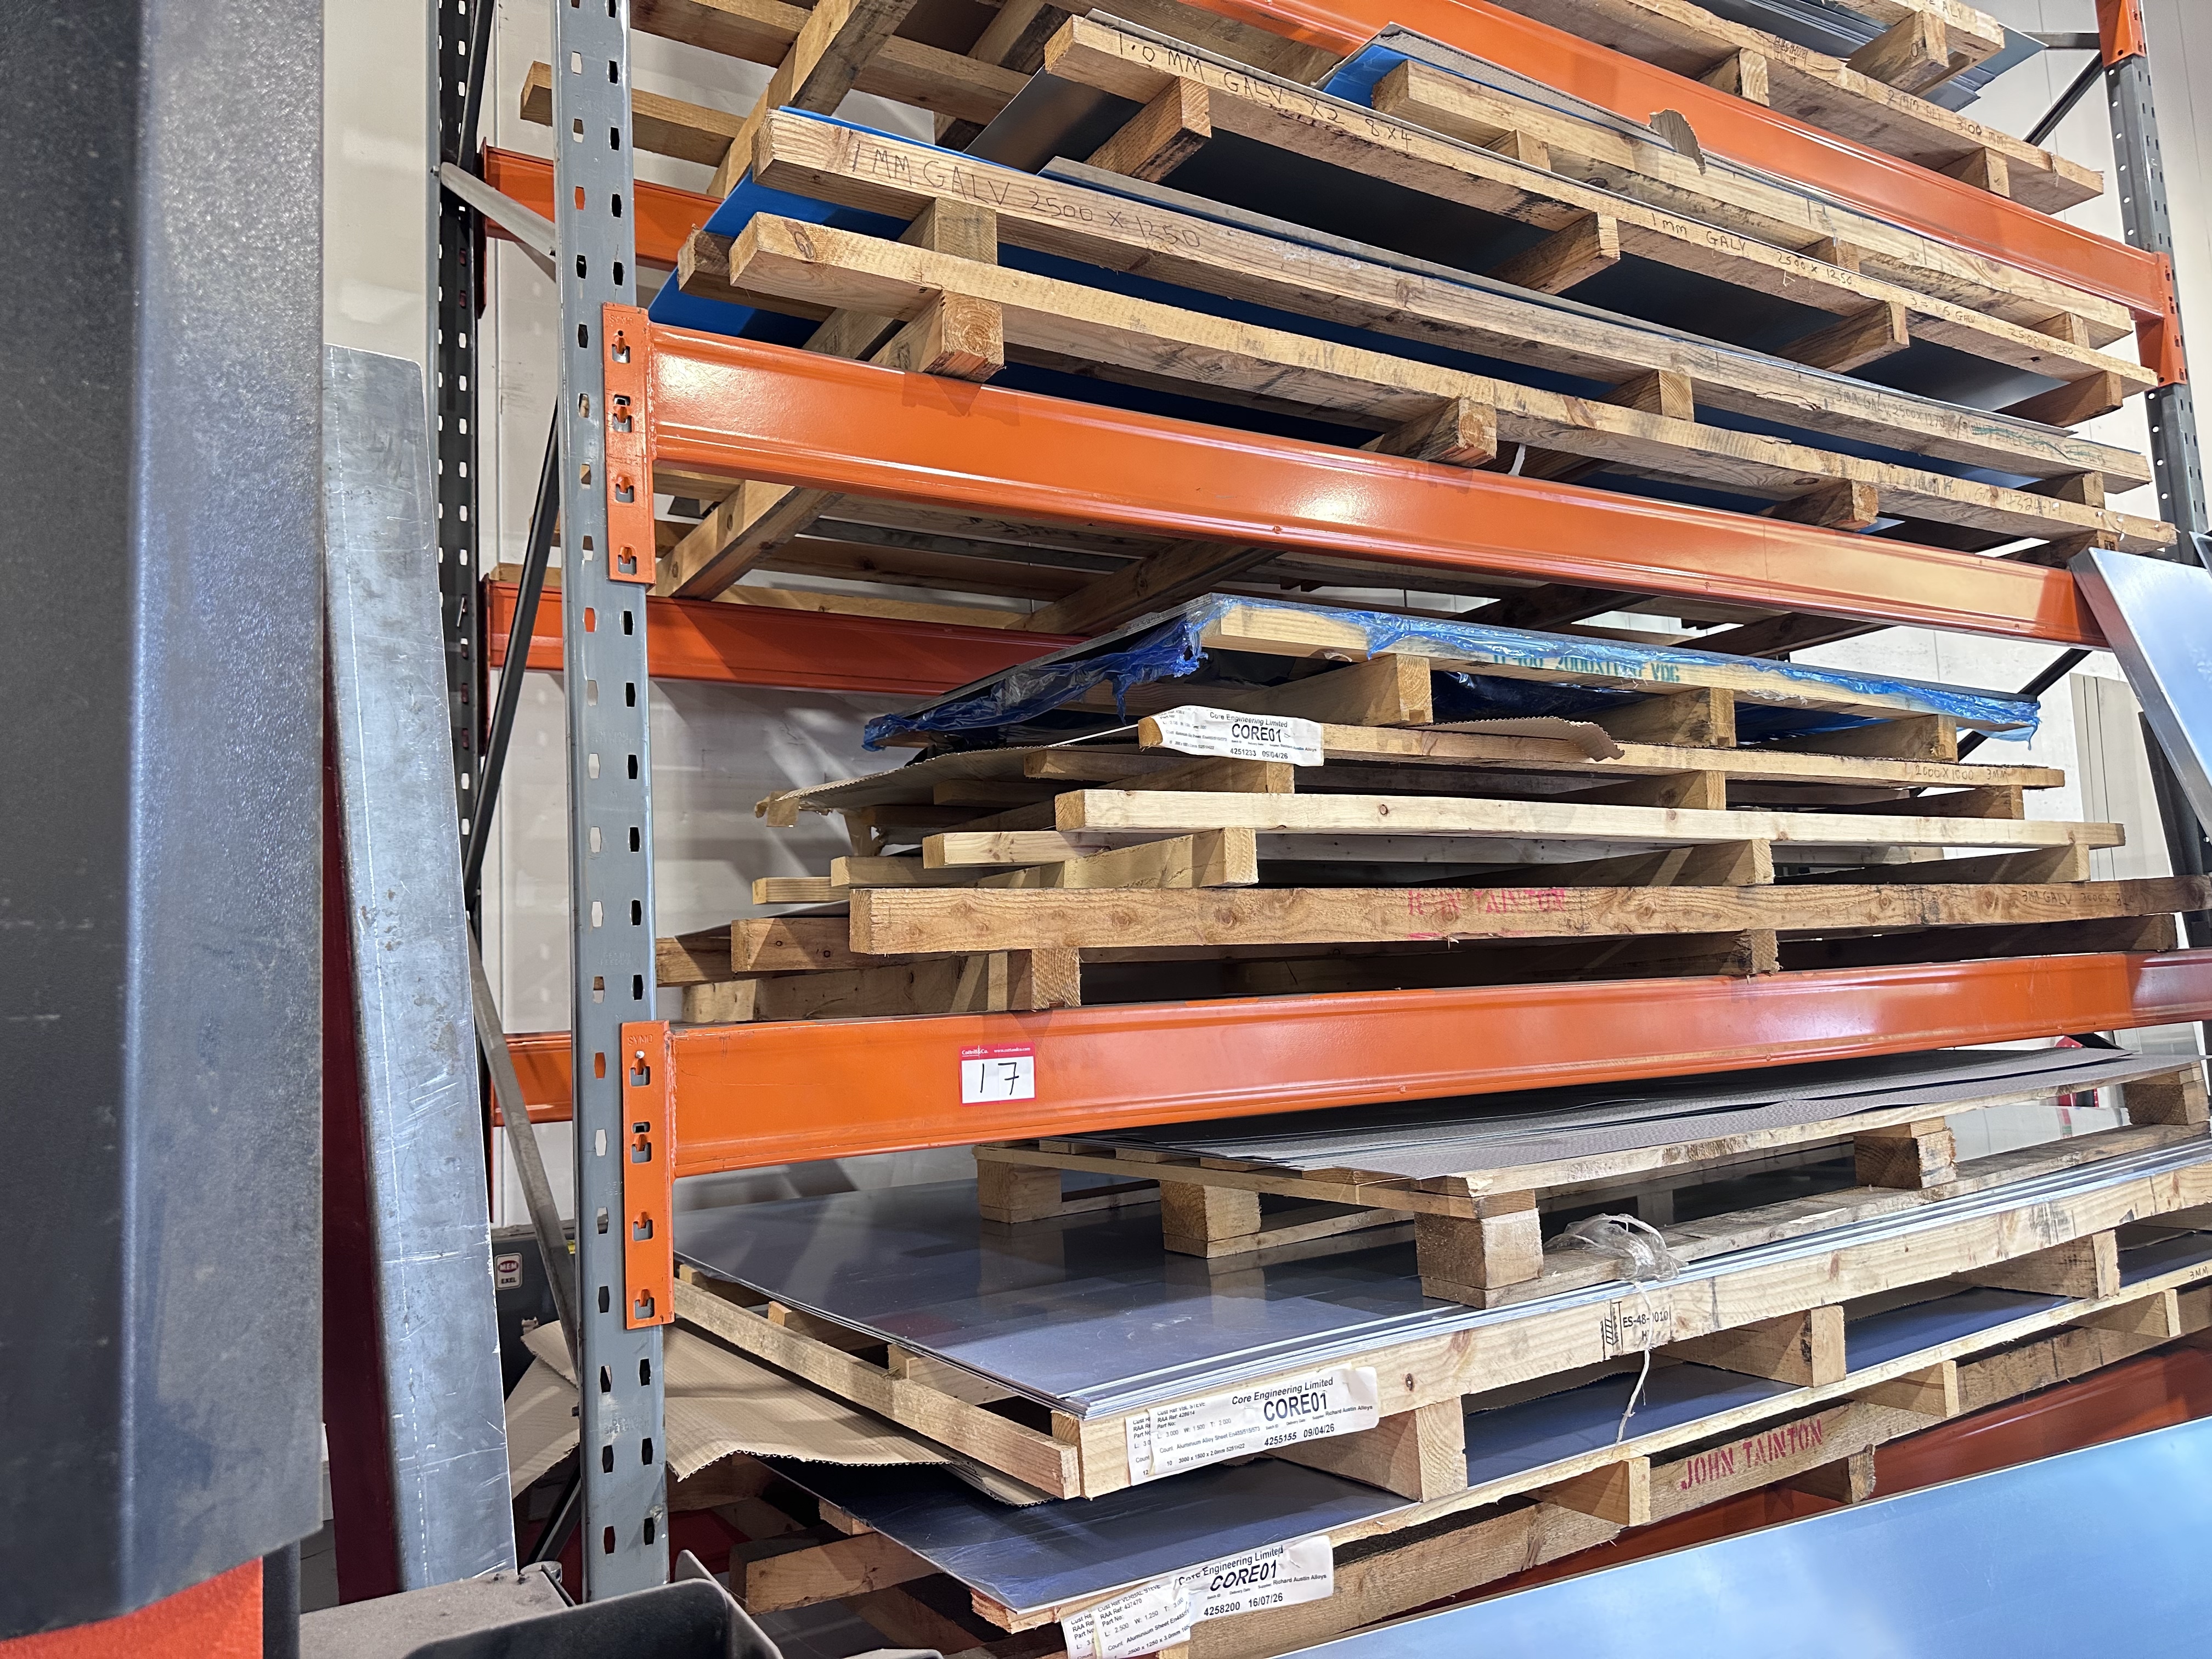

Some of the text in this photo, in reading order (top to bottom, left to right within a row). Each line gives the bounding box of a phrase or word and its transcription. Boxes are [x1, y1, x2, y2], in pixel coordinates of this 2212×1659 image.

[1169, 50, 1204, 81] MM
[1223, 71, 1284, 105] GALV
[1888, 89, 1897, 103] 2
[873, 149, 911, 184] MM
[923, 160, 1010, 206] GALV
[1029, 190, 1093, 222] 2500
[1136, 216, 1201, 247] 1250
[1651, 213, 1656, 226] 1
[1706, 230, 1746, 251] GALV
[1777, 251, 1805, 269] 2500
[1827, 268, 1852, 285] 1250
[2008, 328, 2039, 342] 2500
[1226, 714, 1264, 726] Engineering
[1266, 719, 1288, 727] Limited
[1232, 724, 1282, 742] CORE01
[1230, 748, 1256, 757] 4251233
[2043, 891, 2072, 905] GALV
[980, 1062, 1019, 1095] 17
[2190, 1266, 2208, 1279] 3MM
[1623, 1311, 1668, 1328] ES-48-010
[1232, 1376, 1333, 1404] Core Engineering Limited
[1264, 1391, 1327, 1421] CORE01
[1265, 1423, 1335, 1446] 4255155 09/04/26
[1680, 1419, 1822, 1490] JOHN TAINTON
[1178, 1545, 1283, 1585] Core Engineering Limited
[1210, 1560, 1276, 1592] CORE01
[1100, 1611, 1112, 1620] RAA
[1124, 1598, 1142, 1609] 437470
[1204, 1601, 1240, 1616] 4258200
[1249, 1592, 1283, 1607] 16/07/26
[1114, 1623, 1129, 1633] 2.500
[1144, 1611, 1159, 1620] 1.250
[1108, 1621, 1169, 1651] Count Aluminium Sheet
[1127, 1646, 1141, 1655] 2500
[1146, 1639, 1158, 1647] 1250
